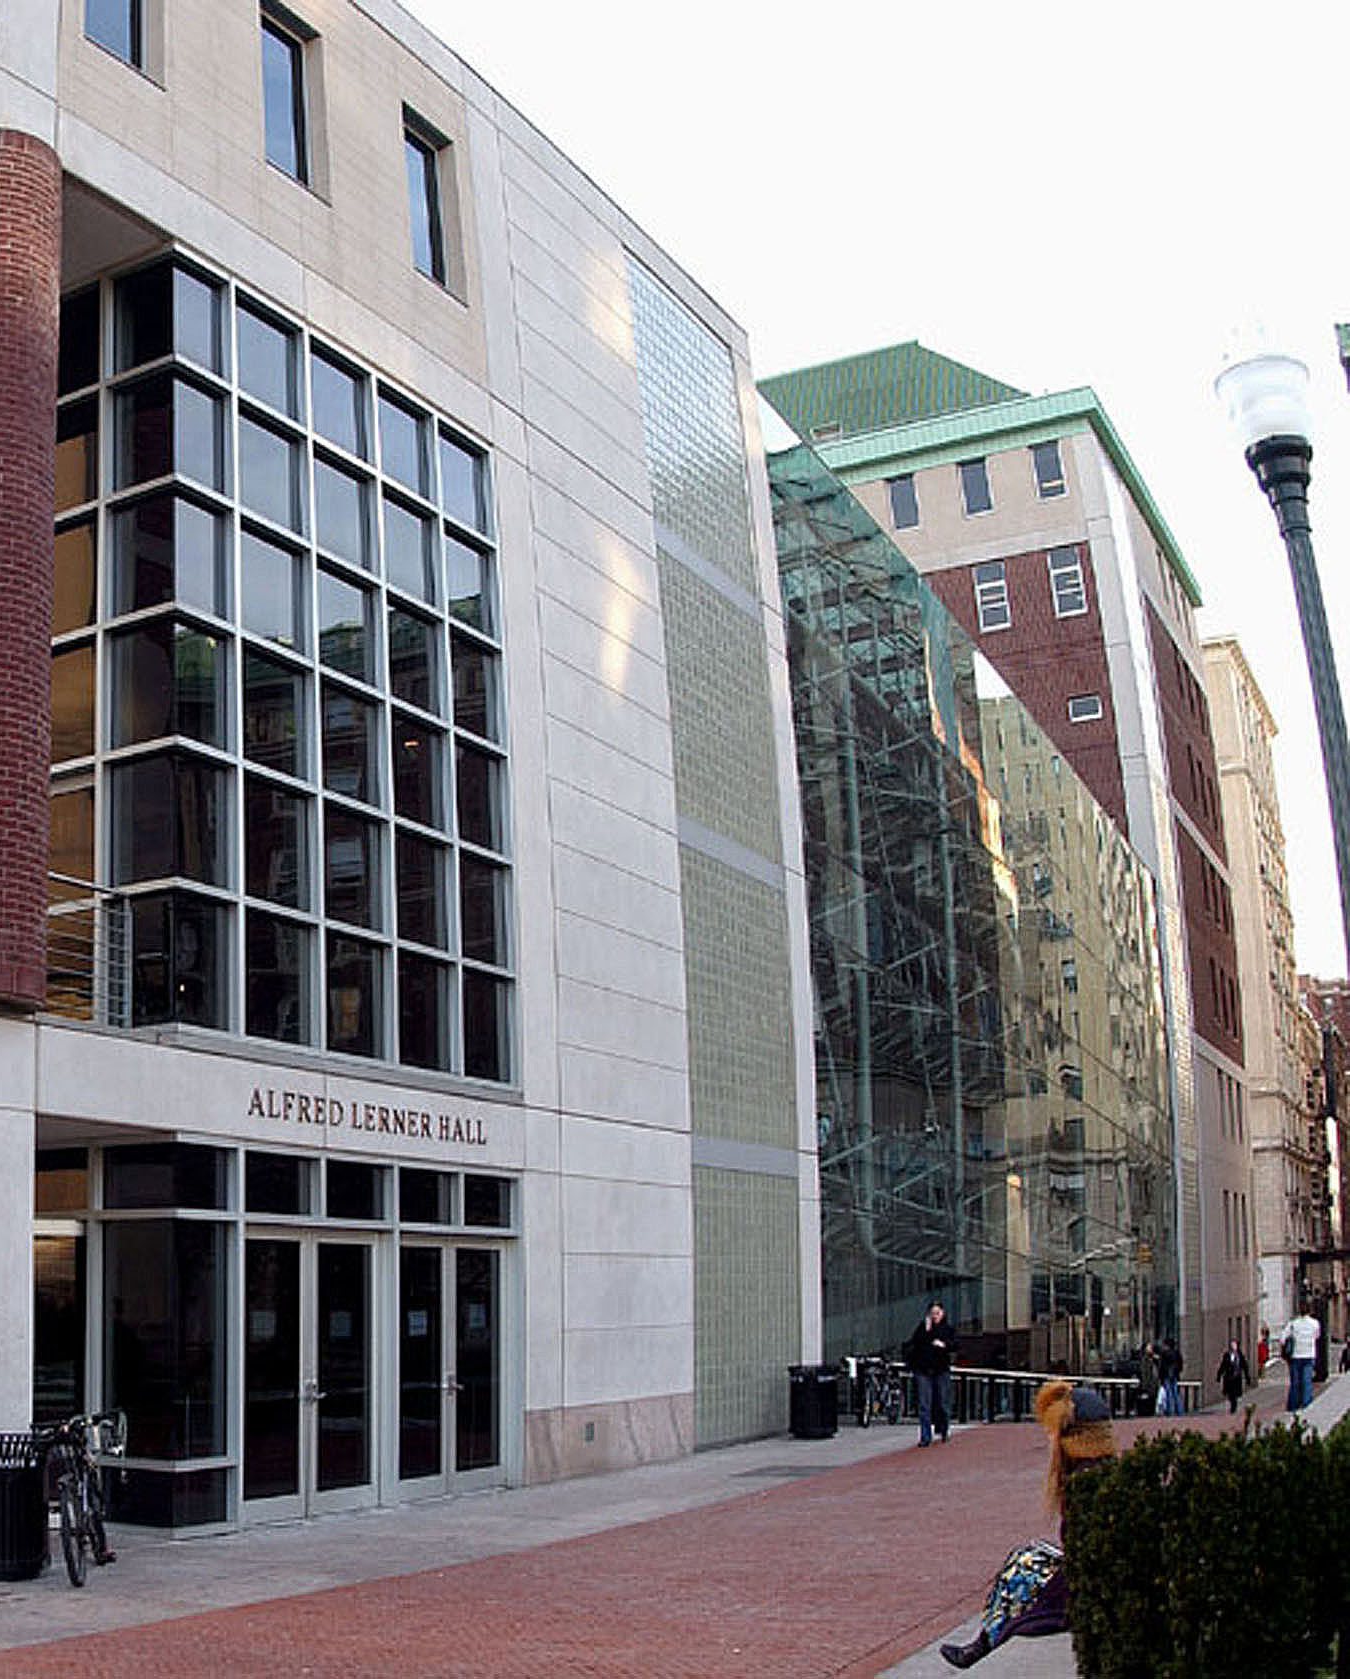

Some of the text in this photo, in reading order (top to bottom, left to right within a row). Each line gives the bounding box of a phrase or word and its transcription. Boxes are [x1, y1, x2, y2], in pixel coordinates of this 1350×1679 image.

[247, 1087, 487, 1145] ALFRED LERNER HALL
